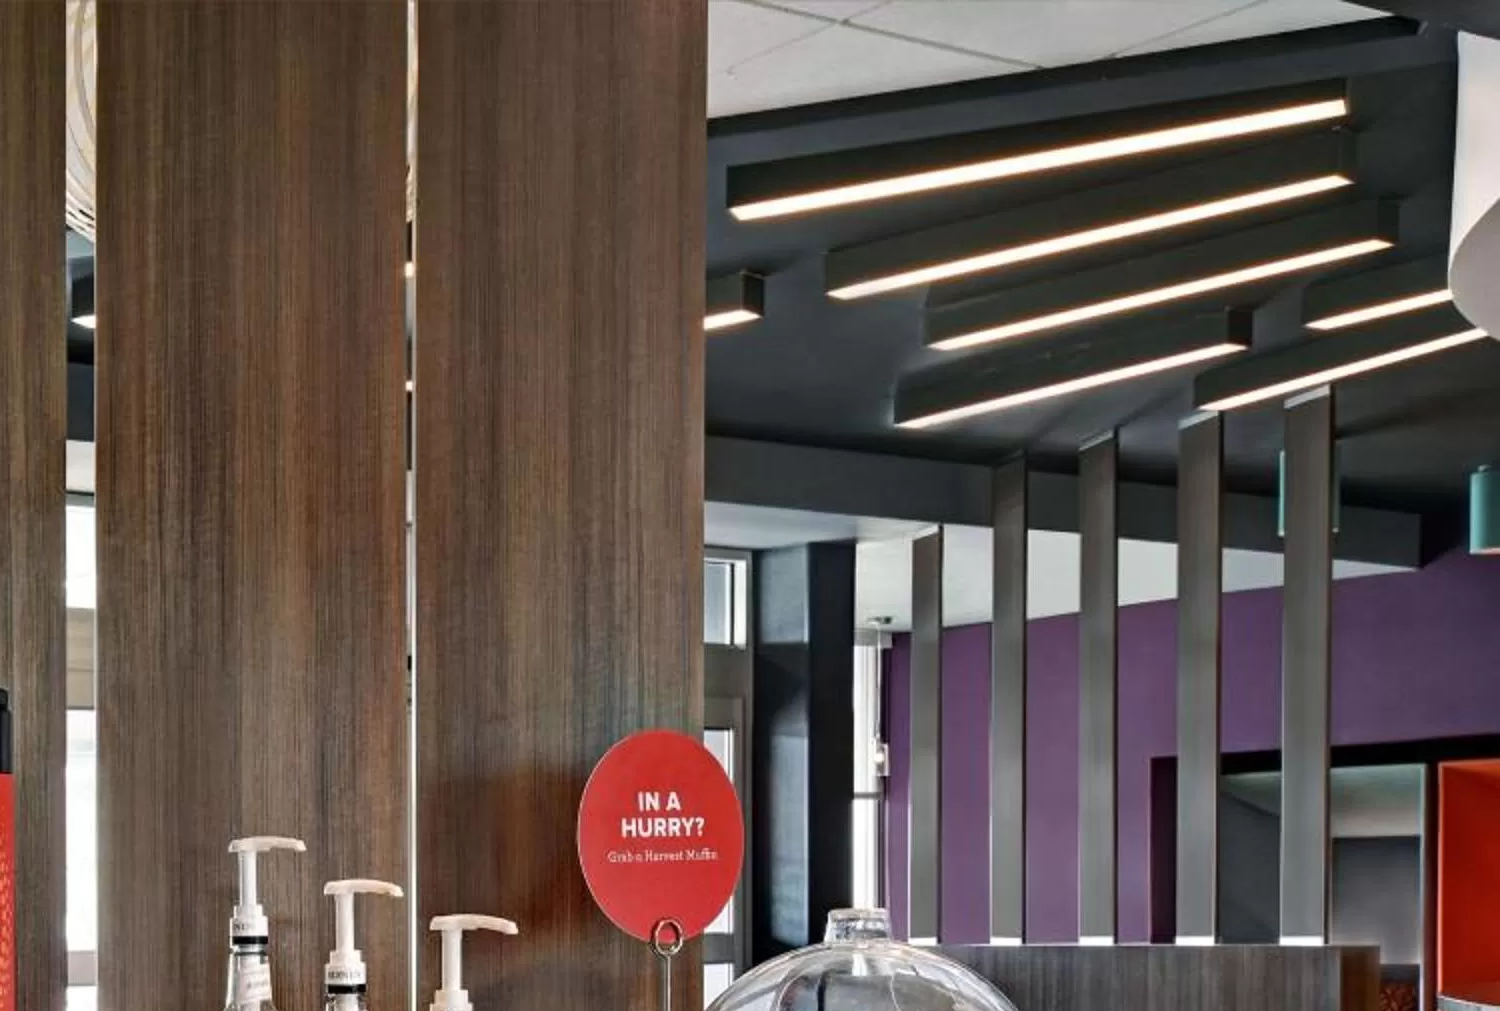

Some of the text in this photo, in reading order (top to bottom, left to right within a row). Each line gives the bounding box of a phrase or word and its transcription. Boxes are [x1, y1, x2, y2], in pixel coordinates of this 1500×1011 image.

[637, 791, 682, 811] IN A
[621, 817, 705, 838] HURRY?
